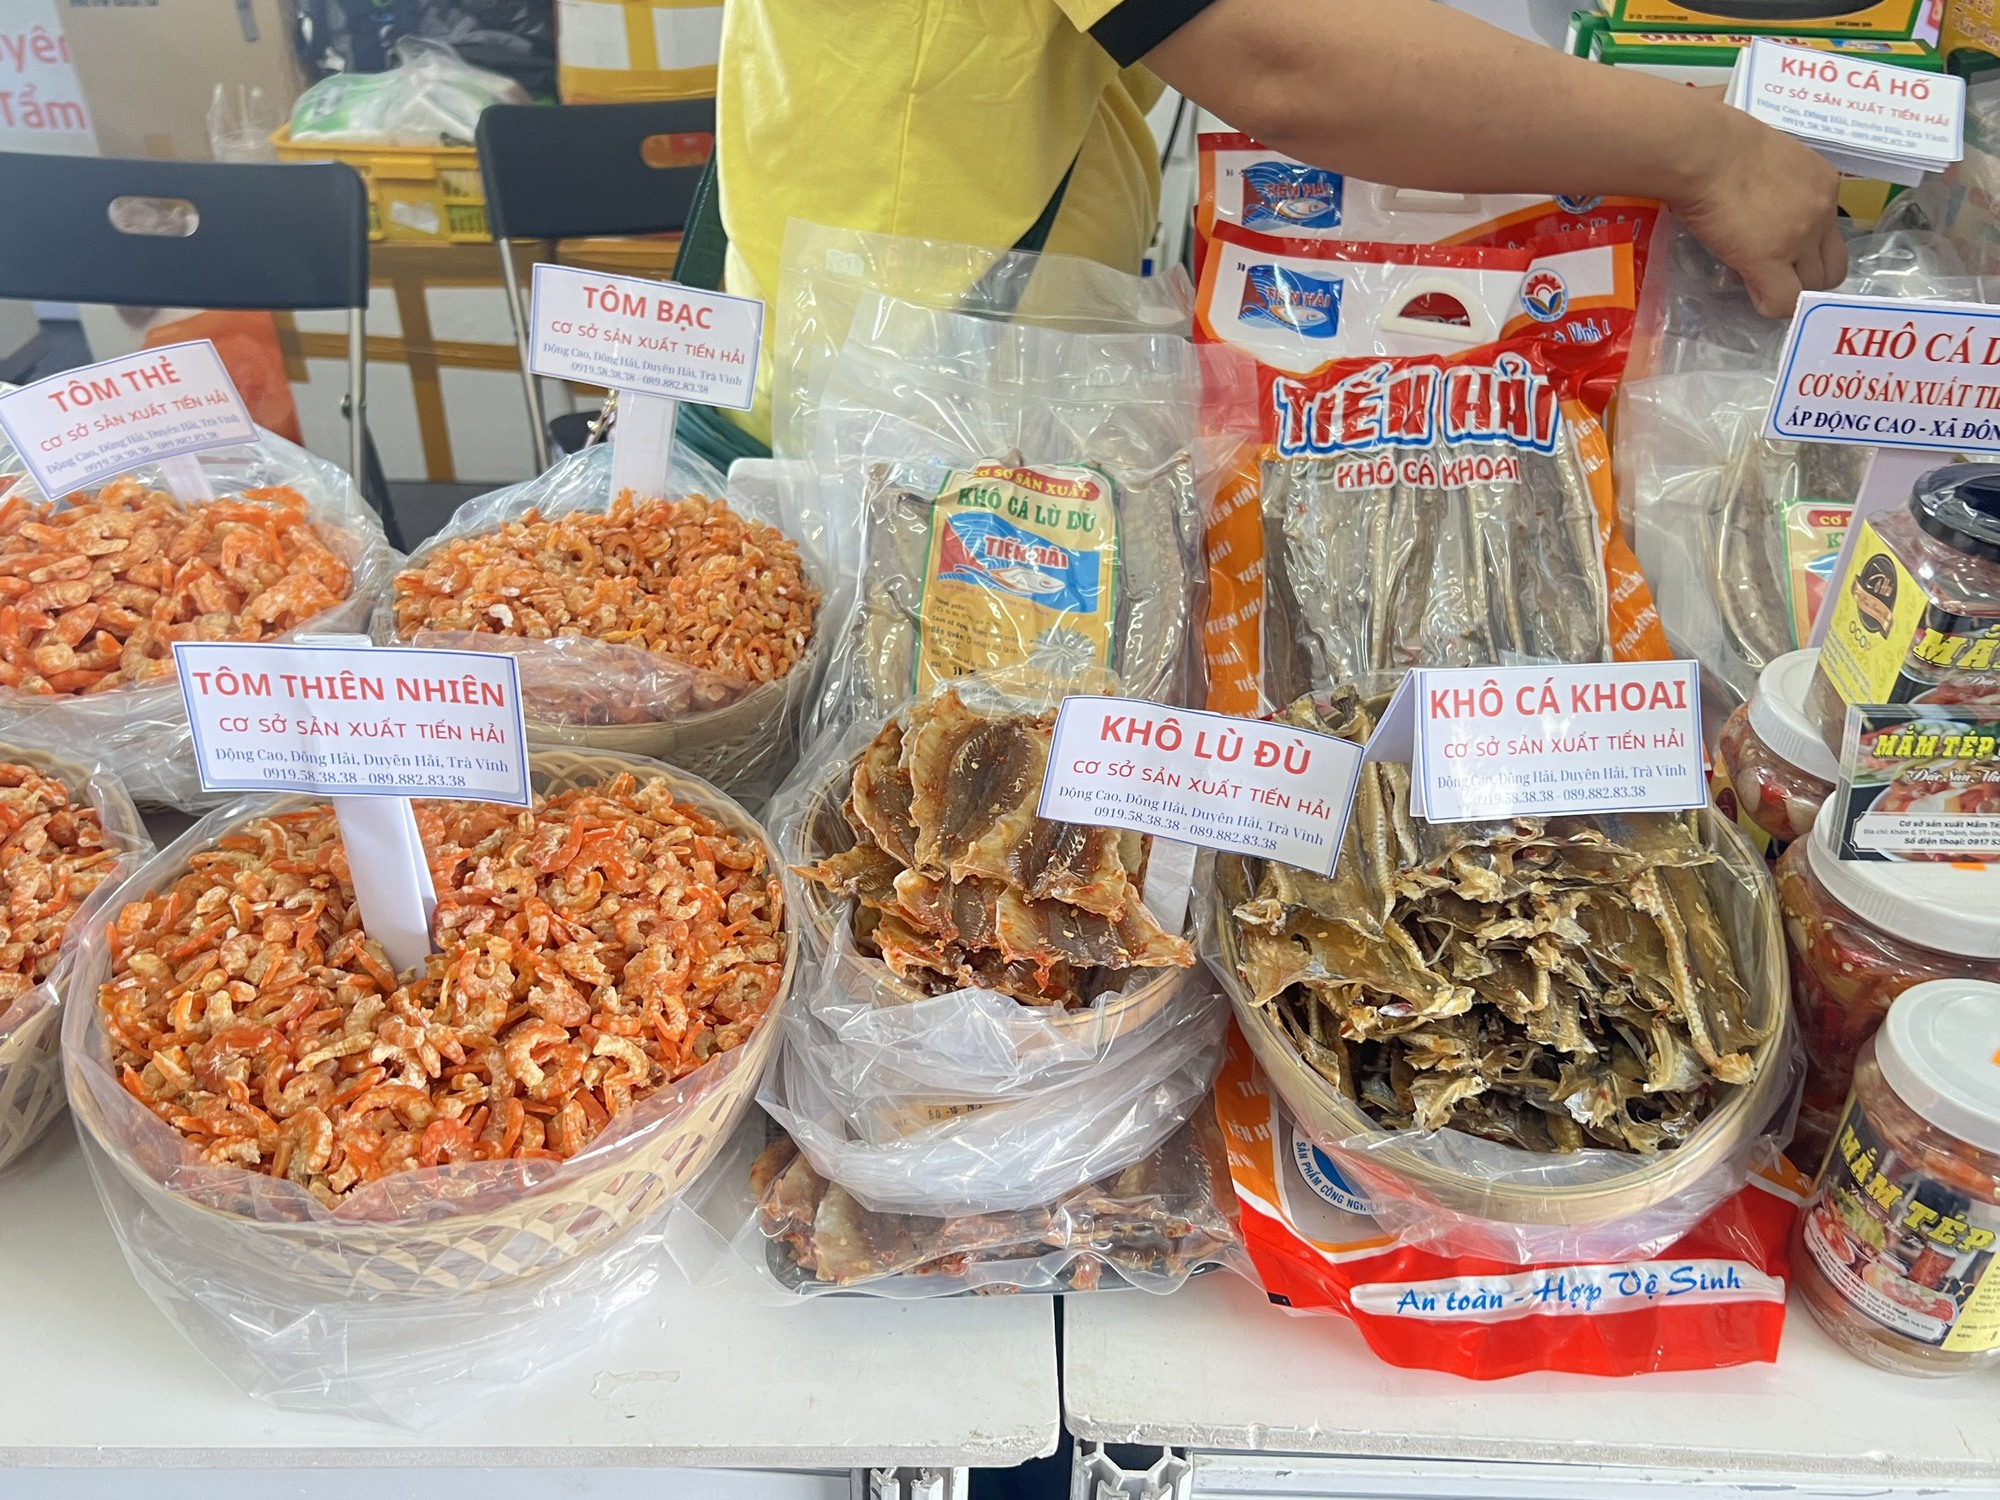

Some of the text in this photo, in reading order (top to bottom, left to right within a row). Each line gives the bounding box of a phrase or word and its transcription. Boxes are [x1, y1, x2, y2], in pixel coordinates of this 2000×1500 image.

[0, 25, 70, 73] yê
[1781, 57, 1838, 82] KHÔ
[1847, 69, 1881, 92] CÁ
[1764, 83, 1950, 127] CƠ SỞ SẢN XUẤT TIẾN HẢI
[583, 284, 713, 332] TÔM BẠC
[551, 320, 745, 365] CƠ SỞ SẢN XUẤT TIẾN HẢI
[1567, 318, 1602, 343] Vinh
[1833, 321, 1917, 359] KHÔ
[1925, 326, 1975, 364] CÁ
[48, 356, 181, 413] TÔM THẺ
[719, 372, 742, 386] Vinh
[1798, 373, 1833, 398] CƠ
[1833, 370, 1865, 399] SỞ
[1865, 372, 1908, 403] SẢN
[1910, 376, 1972, 407] XUẤT
[40, 389, 230, 452] CƠ SỞ SẢN XUẤT TIẾN HẢI
[1277, 352, 1559, 458] TIẾN HẢI
[1786, 405, 1813, 427] ẤP
[1814, 410, 1870, 433] ĐỘNG
[1874, 416, 1915, 435] CAO
[1929, 417, 1957, 438] XÃ
[1016, 472, 1043, 491] SẢN
[1337, 454, 1521, 490] KHÔ CÁ KHOAI
[957, 487, 1002, 510] KHÔ
[1008, 495, 1028, 520] CÁ
[1035, 504, 1062, 527] LÙ
[1819, 514, 1842, 526] CƠ
[192, 665, 505, 707] TÔM THIÊN NHIÊN
[1430, 677, 1687, 719] KHÔ CÁ KHOAI
[219, 712, 505, 744] CƠ SỞ SẢN XUẤT TIẾN HẢI
[1100, 714, 1311, 775] KHÔ LÙ ĐÙ
[1444, 727, 1685, 759] CƠ SỞ SẢN XUẤT TIẾN HẢI
[1873, 724, 1996, 759] MẮM TÉP
[257, 749, 508, 773] Cao, Hải, Duyên Hải, Trà Vinh
[263, 767, 466, 787] 0919.58.38.38 089.882.83.38
[1533, 769, 1557, 783] Hải,
[1560, 768, 1600, 784] Duyên
[1603, 766, 1628, 779] Hải,
[1631, 765, 1652, 778] Trà
[1656, 763, 1687, 777] Vinh
[1073, 759, 1331, 820] CƠ SỞ SẢN XUẤT TIẾN HẢI
[1563, 785, 1646, 801] 089.882.83.38
[1094, 806, 1278, 851] 0919.58.38.38 089.882.83.38
[1095, 790, 1323, 846] Cao, Hải, Duyên Hải, Trà Vinh
[1296, 1141, 1344, 1204] SẢN PHẨM CÔNG
[1840, 1124, 1903, 1212] MẮM
[1903, 1200, 1997, 1256] TÉP
[1397, 1288, 1436, 1314] An
[1446, 1287, 1503, 1311] toàn
[1533, 1276, 1603, 1311] Hợp
[1609, 1270, 1659, 1300] Vệ
[1665, 1266, 1741, 1296] Sinh
